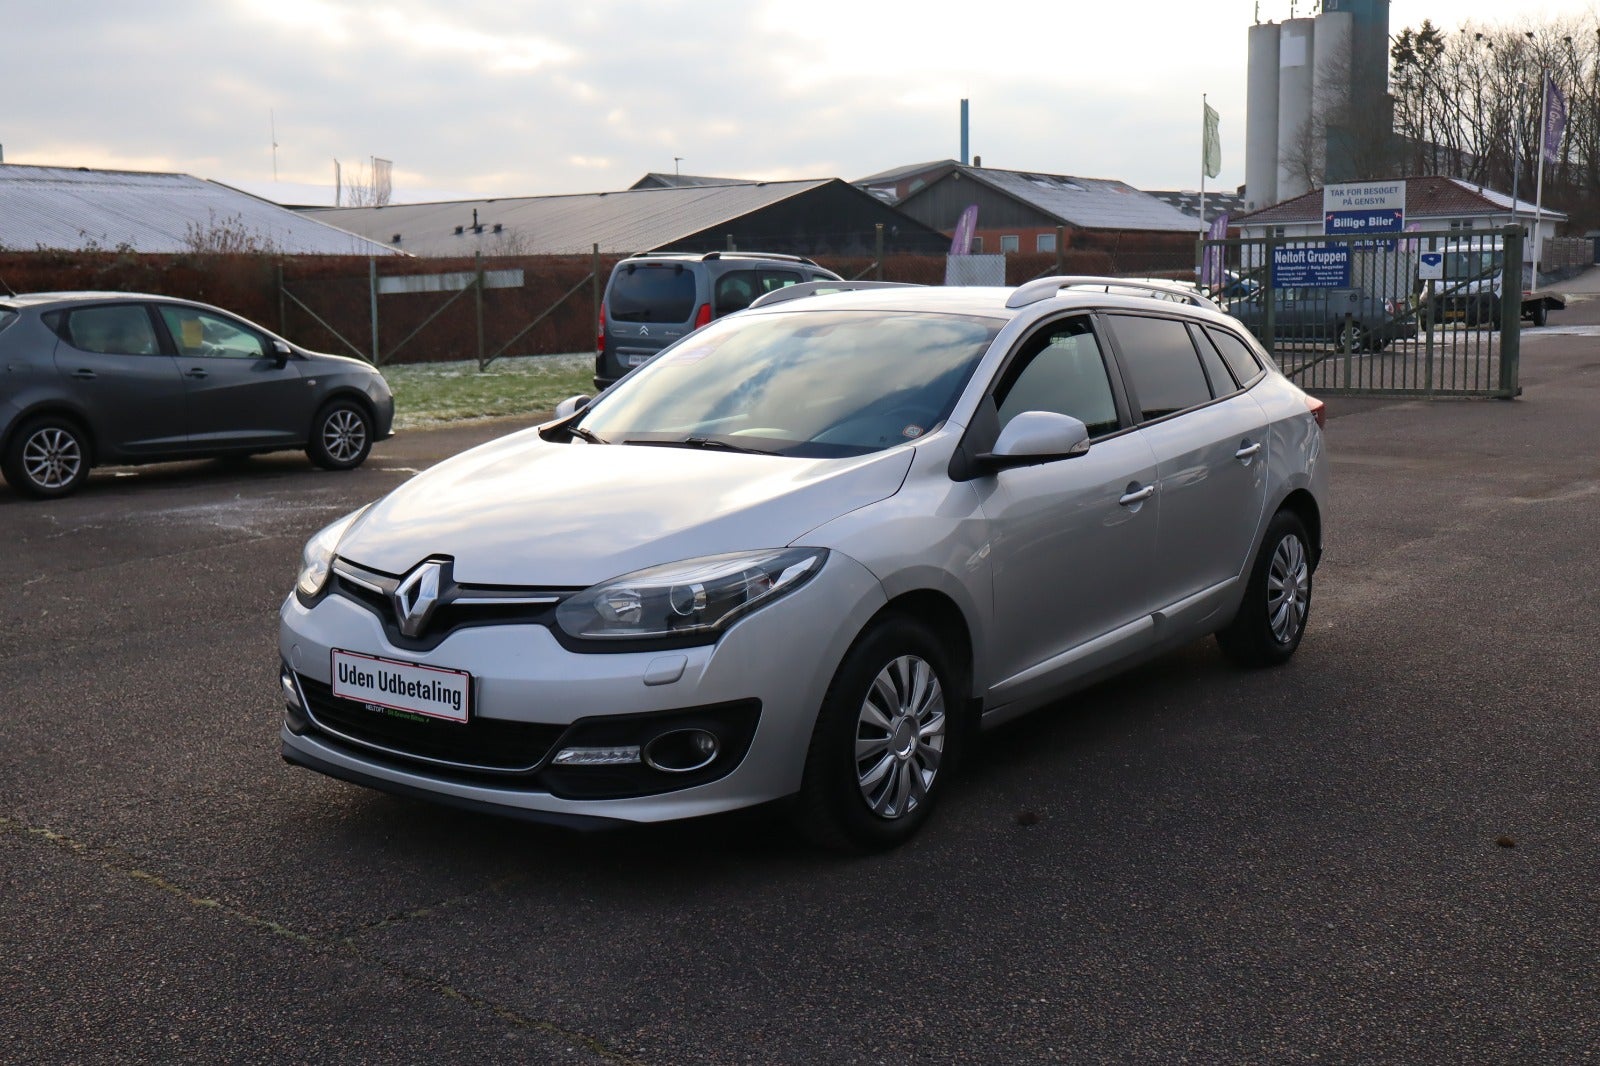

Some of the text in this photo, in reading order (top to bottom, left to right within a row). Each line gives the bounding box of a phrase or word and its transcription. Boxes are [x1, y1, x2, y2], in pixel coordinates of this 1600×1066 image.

[1330, 186, 1399, 197] TAK FOR BESØGET
[1354, 197, 1385, 205] GENSYN
[1333, 216, 1394, 229] Billige Biler
[1274, 250, 1347, 265] Neltoft Gruppen
[338, 662, 462, 711] Uden Udbetaling
[365, 703, 385, 713] NELTOFT
